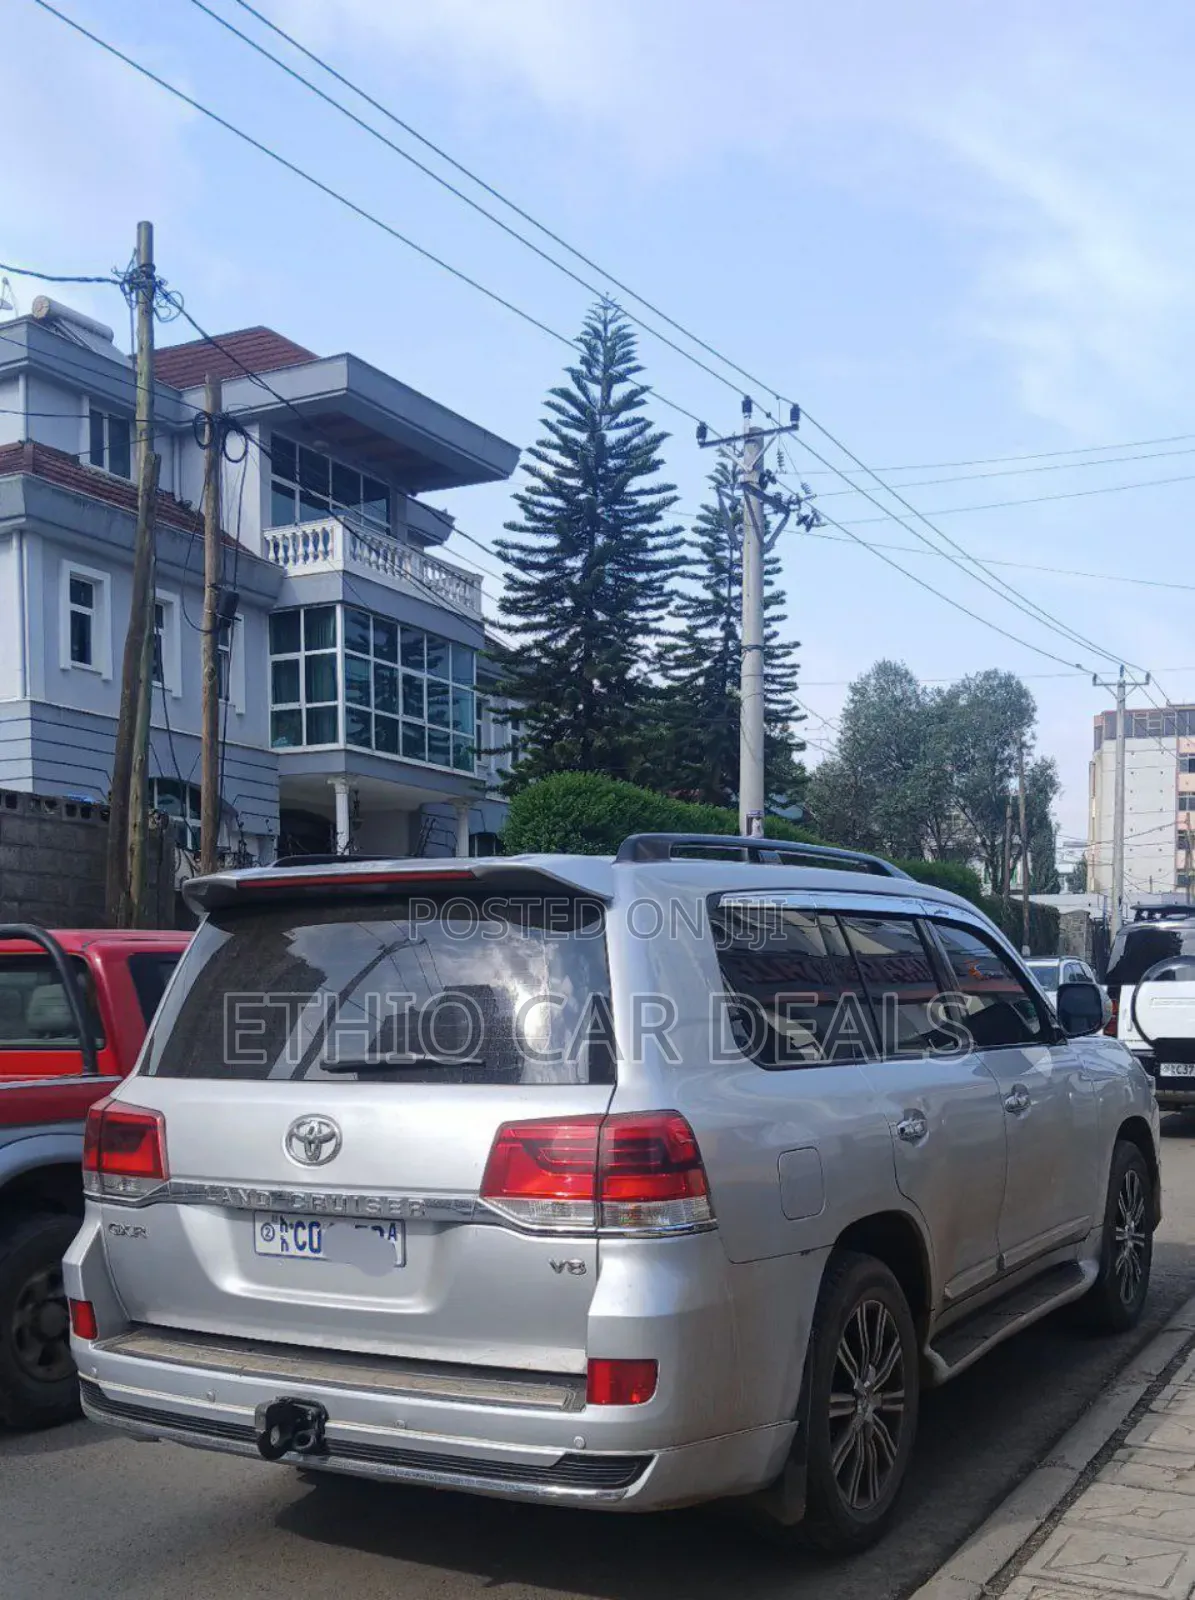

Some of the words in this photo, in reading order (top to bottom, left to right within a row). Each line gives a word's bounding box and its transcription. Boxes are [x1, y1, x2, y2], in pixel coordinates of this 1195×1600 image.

[204, 1185, 272, 1207] LAND
[291, 1192, 426, 1217] CRUISER
[549, 1259, 587, 1276] V8
